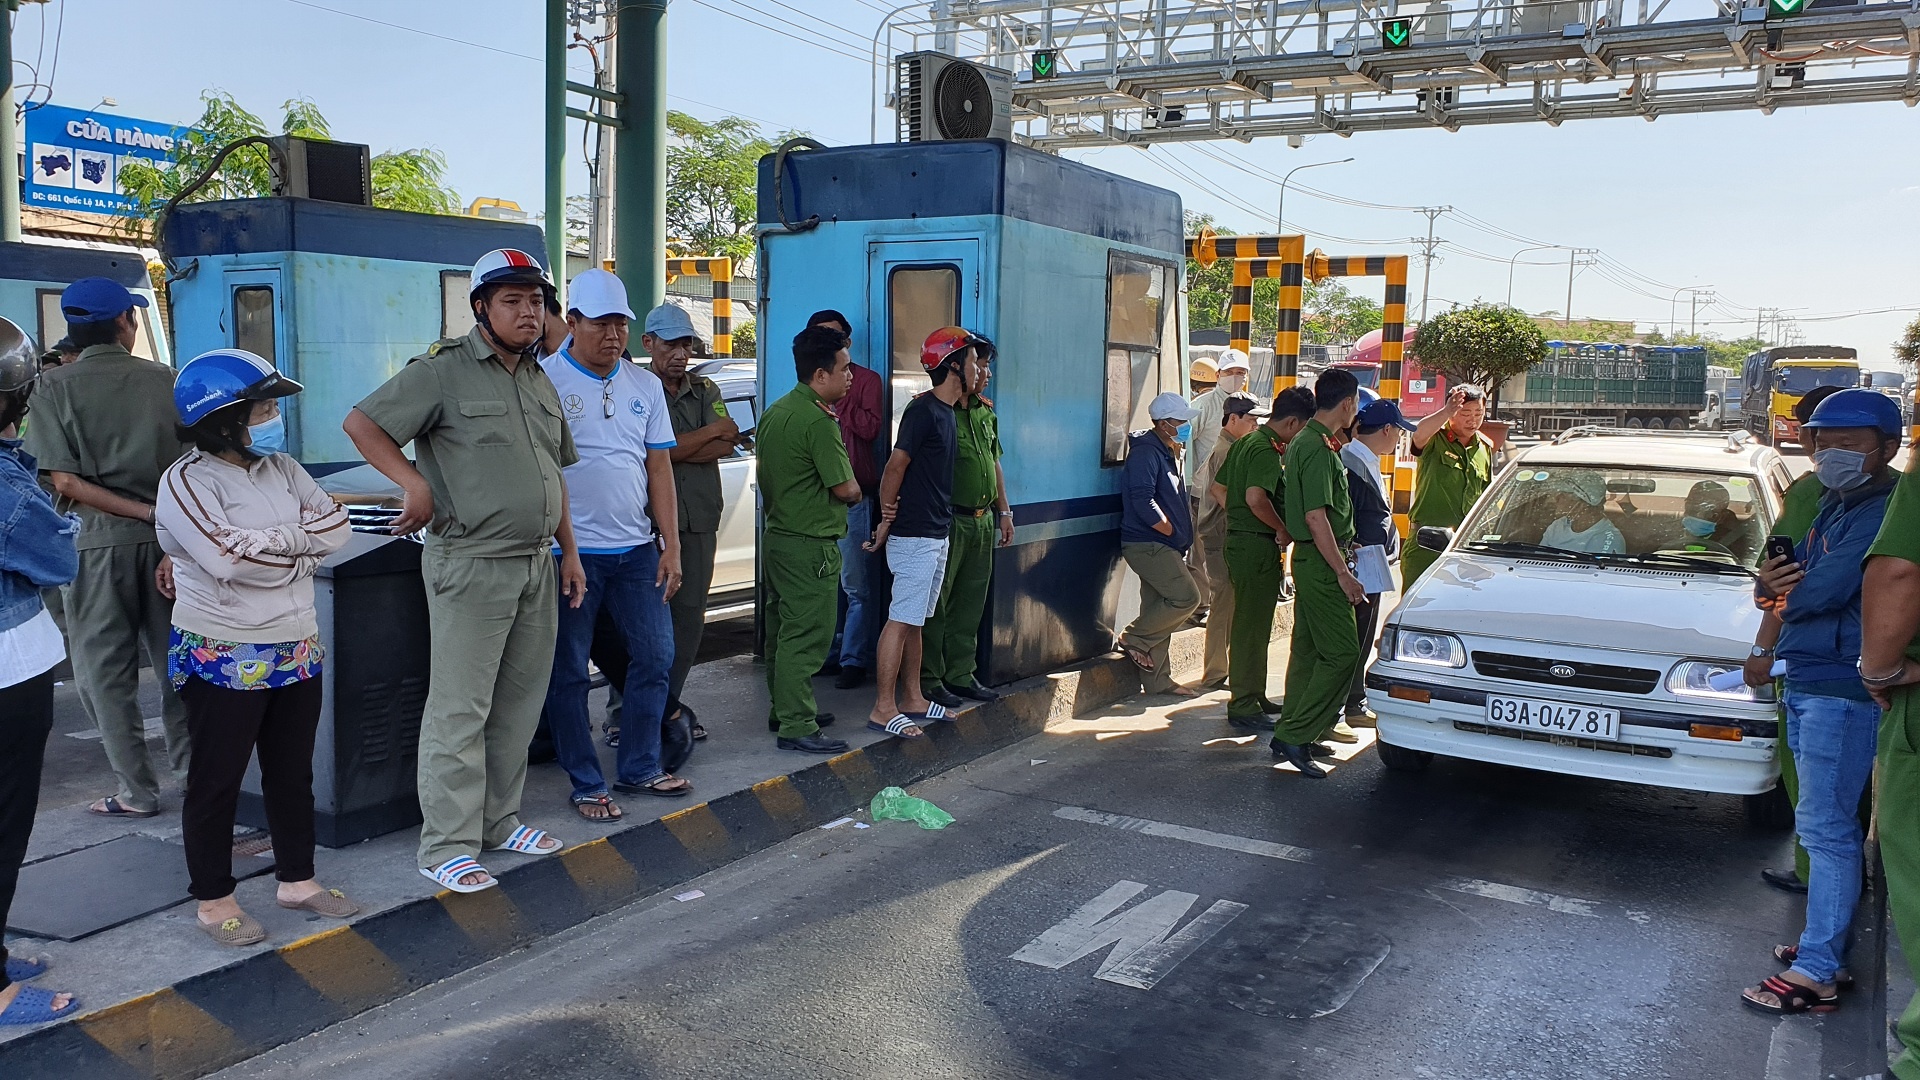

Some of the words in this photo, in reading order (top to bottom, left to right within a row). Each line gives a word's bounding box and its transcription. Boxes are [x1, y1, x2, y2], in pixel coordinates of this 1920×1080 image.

[66, 117, 113, 142] CỬA
[115, 126, 174, 151] HÀNG
[47, 193, 62, 202] 661
[64, 195, 82, 205] Quốc
[83, 197, 93, 207] Lộ
[185, 389, 223, 412] Sacombank
[1490, 698, 1612, 736] 63A-047.81
